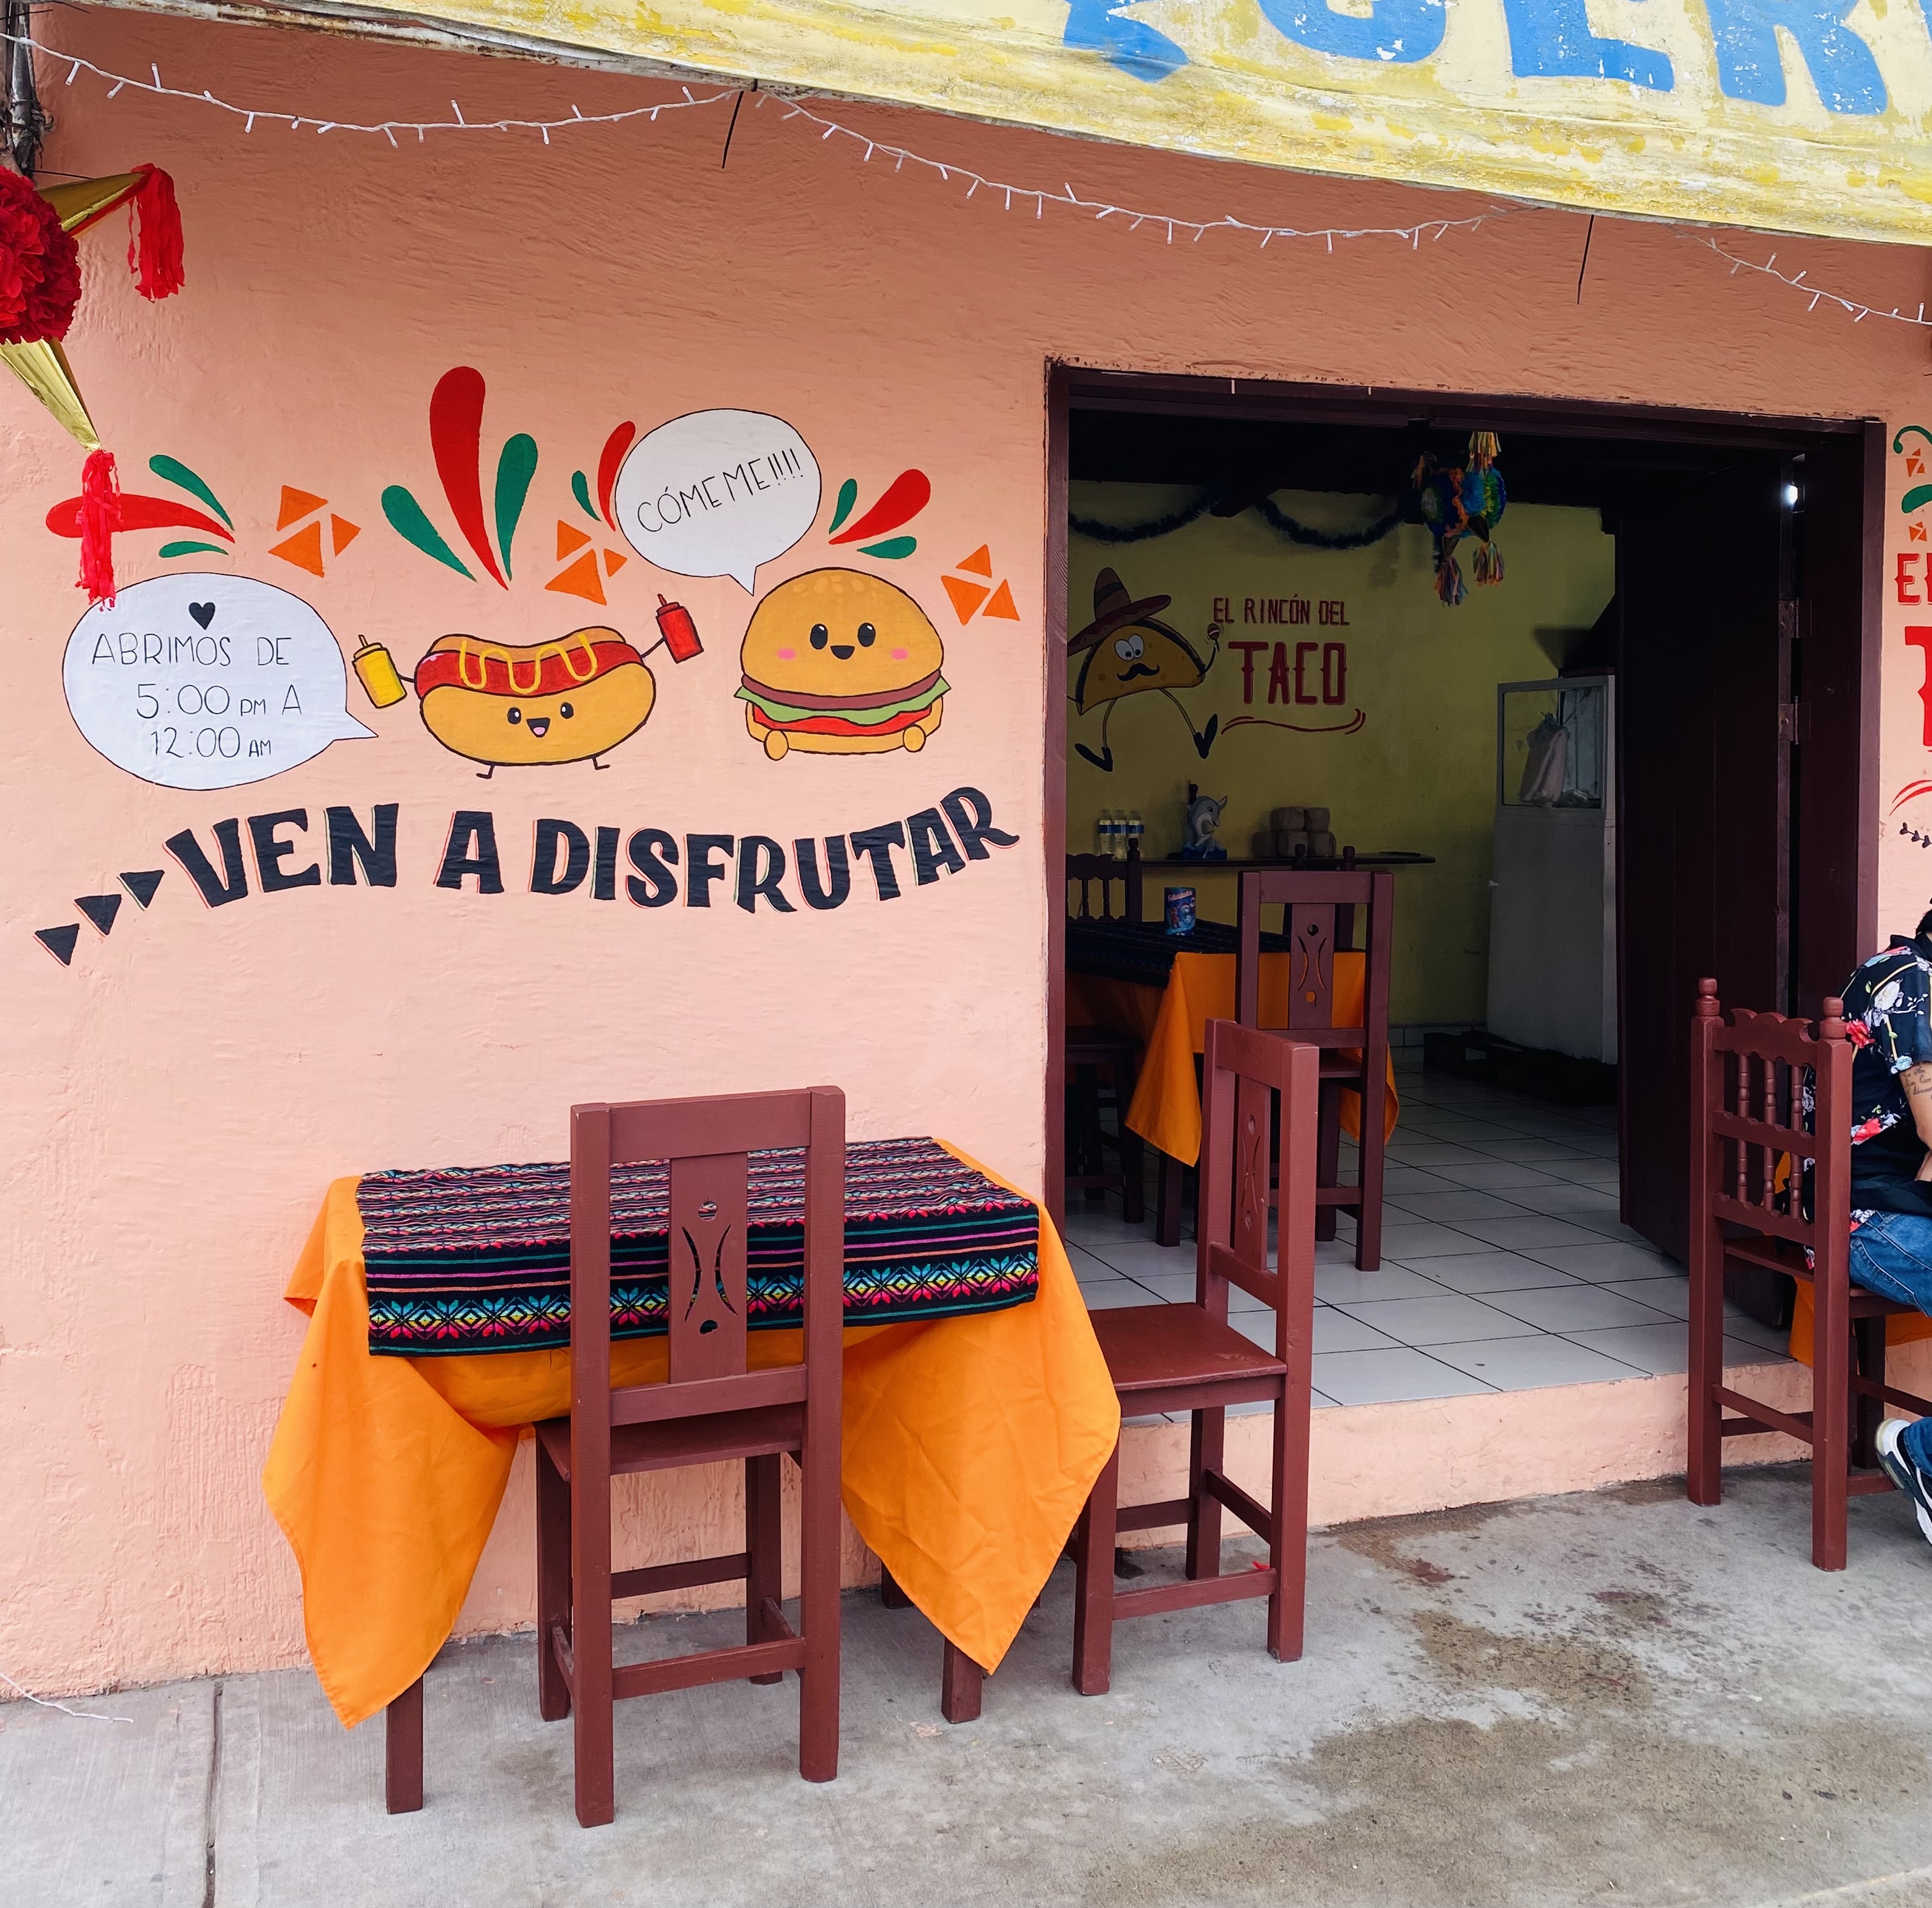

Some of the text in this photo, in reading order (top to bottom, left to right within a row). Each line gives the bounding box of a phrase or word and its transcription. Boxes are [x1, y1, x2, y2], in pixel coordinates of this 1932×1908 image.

[1894, 553, 1932, 606] E
[1213, 594, 1350, 626] EL RINCÓN DEL
[92, 633, 292, 666] ABRIMOS DE
[1228, 642, 1347, 705] TACO
[136, 684, 230, 719] 5:00
[282, 684, 302, 715] A
[151, 727, 271, 758] 12:00 AM
[164, 787, 1020, 914] VEN A DISFRUTAR
